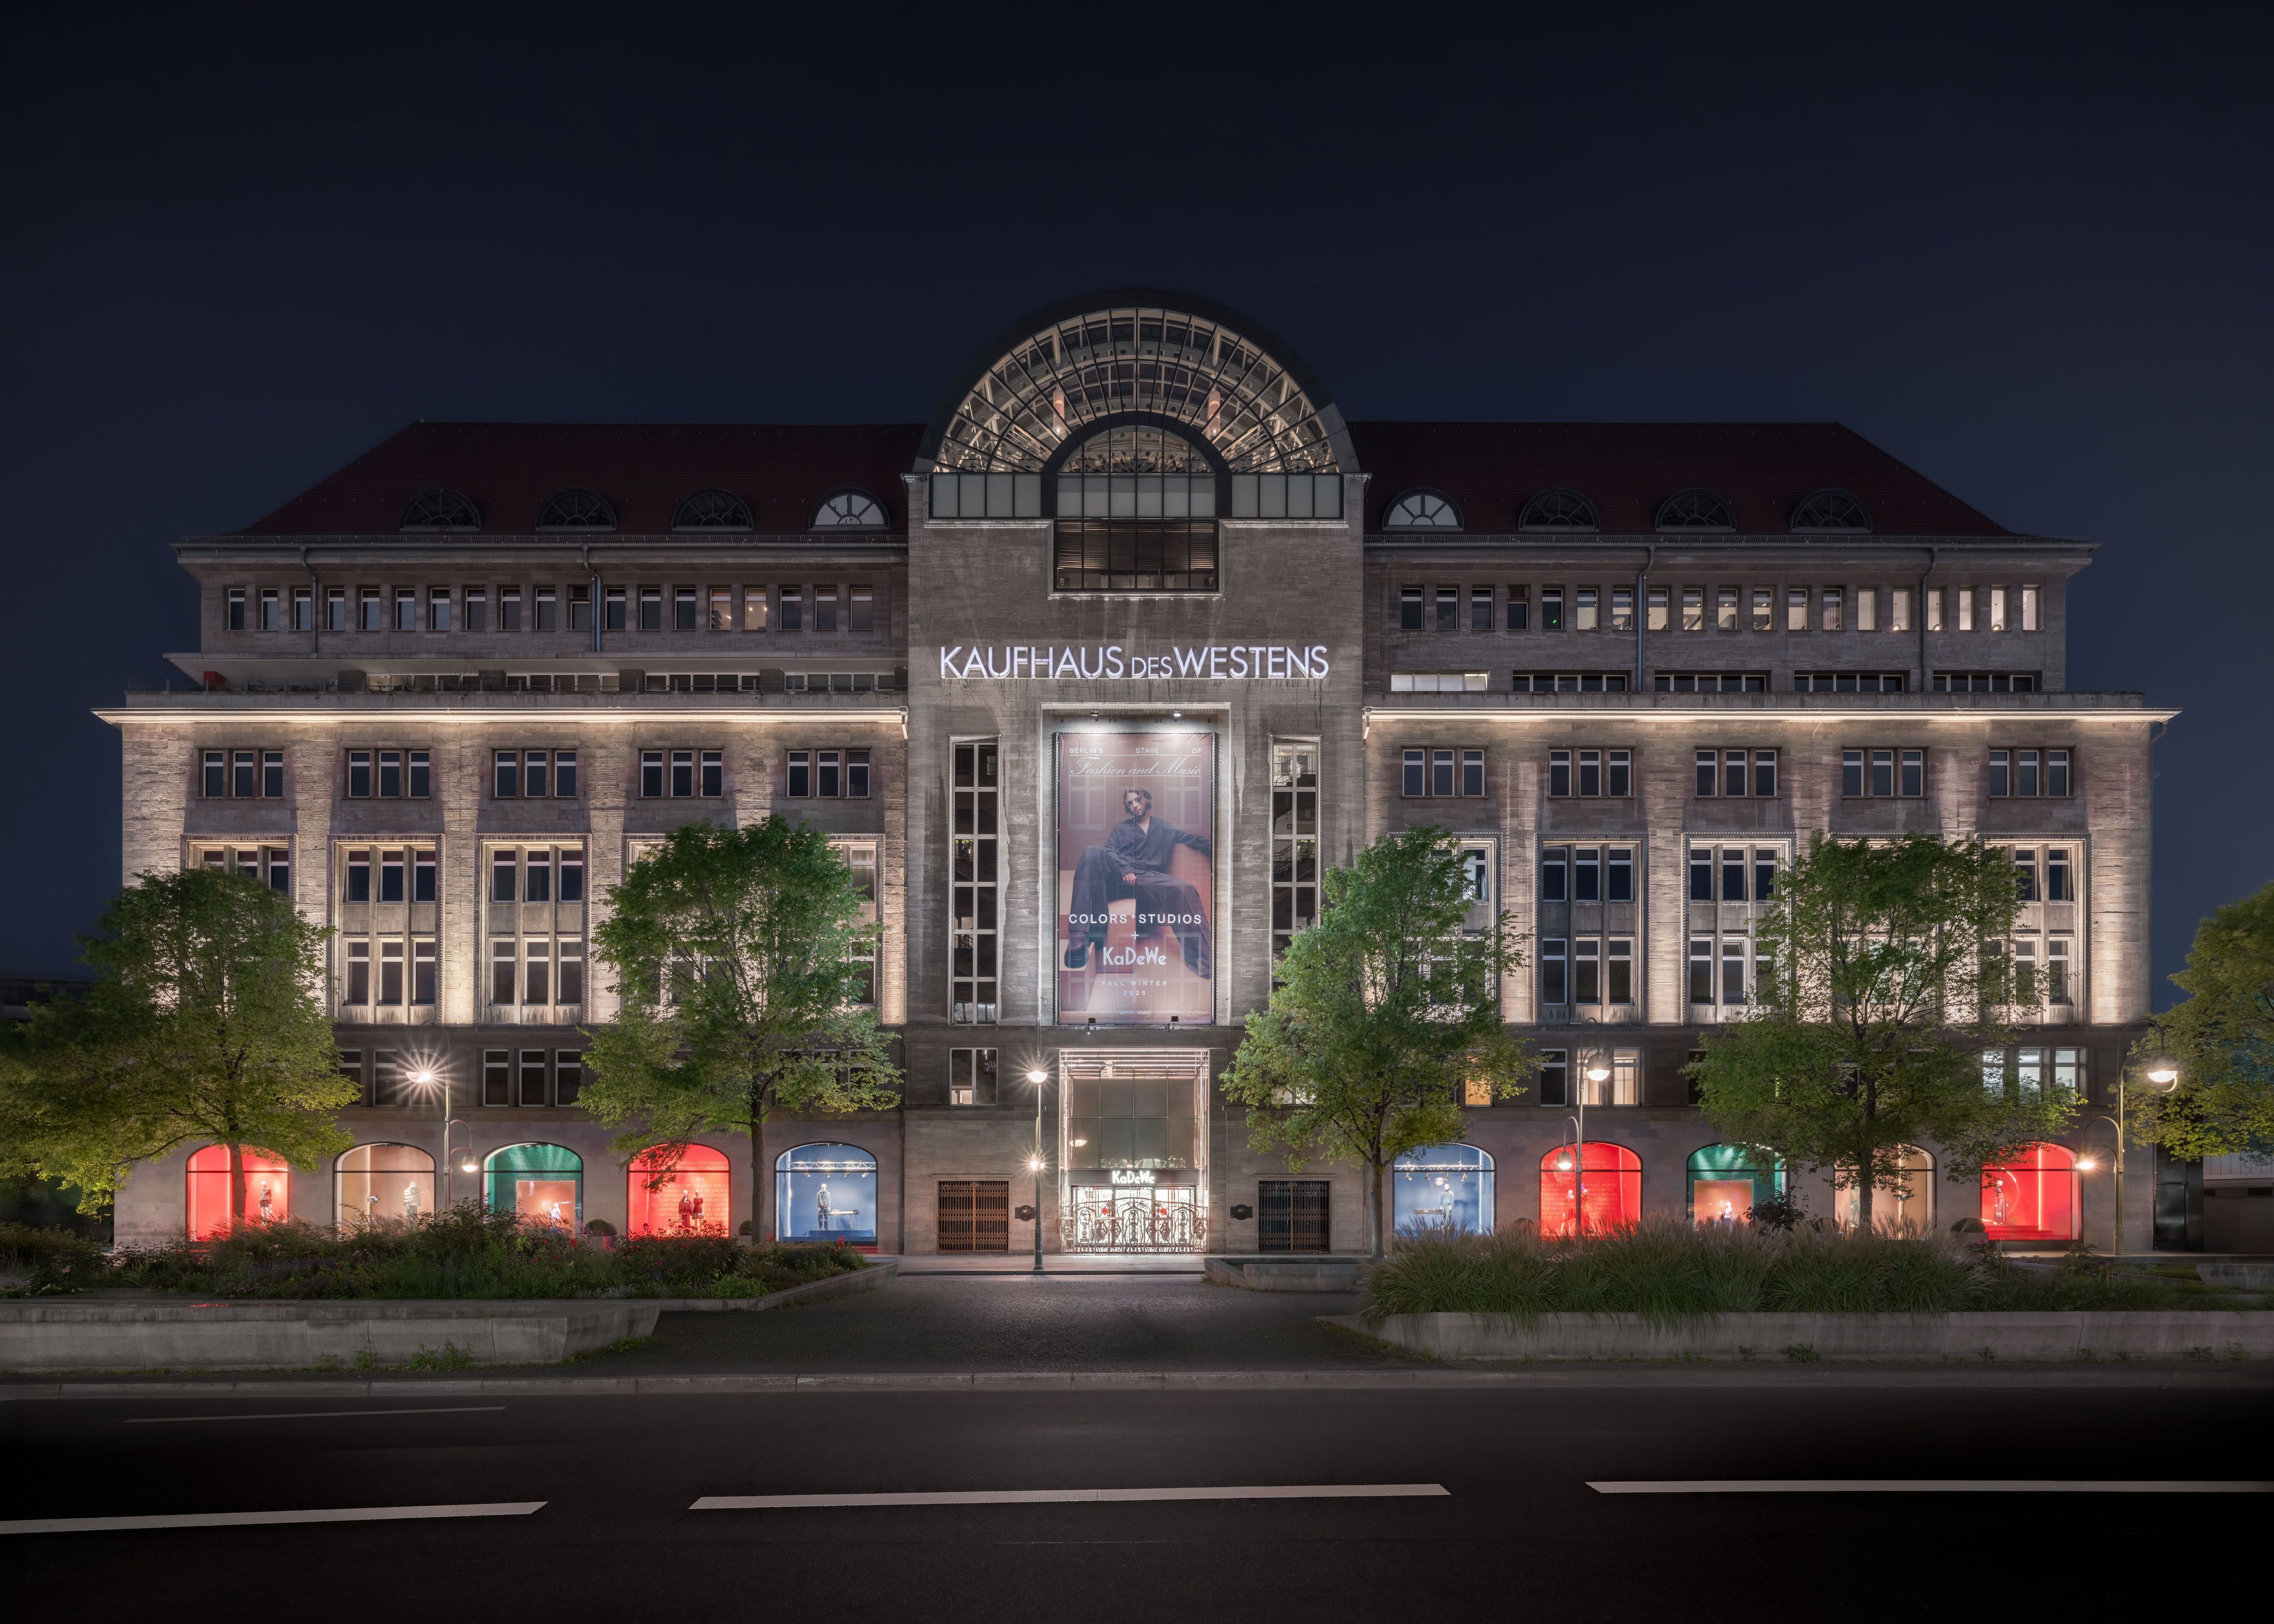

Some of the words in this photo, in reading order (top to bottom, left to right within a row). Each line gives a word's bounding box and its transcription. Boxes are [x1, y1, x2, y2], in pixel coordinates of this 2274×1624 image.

[941, 646, 1124, 679] KAUFHAUS
[1132, 657, 1173, 678] DES
[1173, 646, 1330, 679] WESTENS
[1070, 757, 1126, 775] Fashion
[1128, 762, 1159, 775] and
[1157, 757, 1201, 775] Music
[1103, 946, 1167, 965] KaDeWe
[1111, 1170, 1155, 1184] KaDeWe
